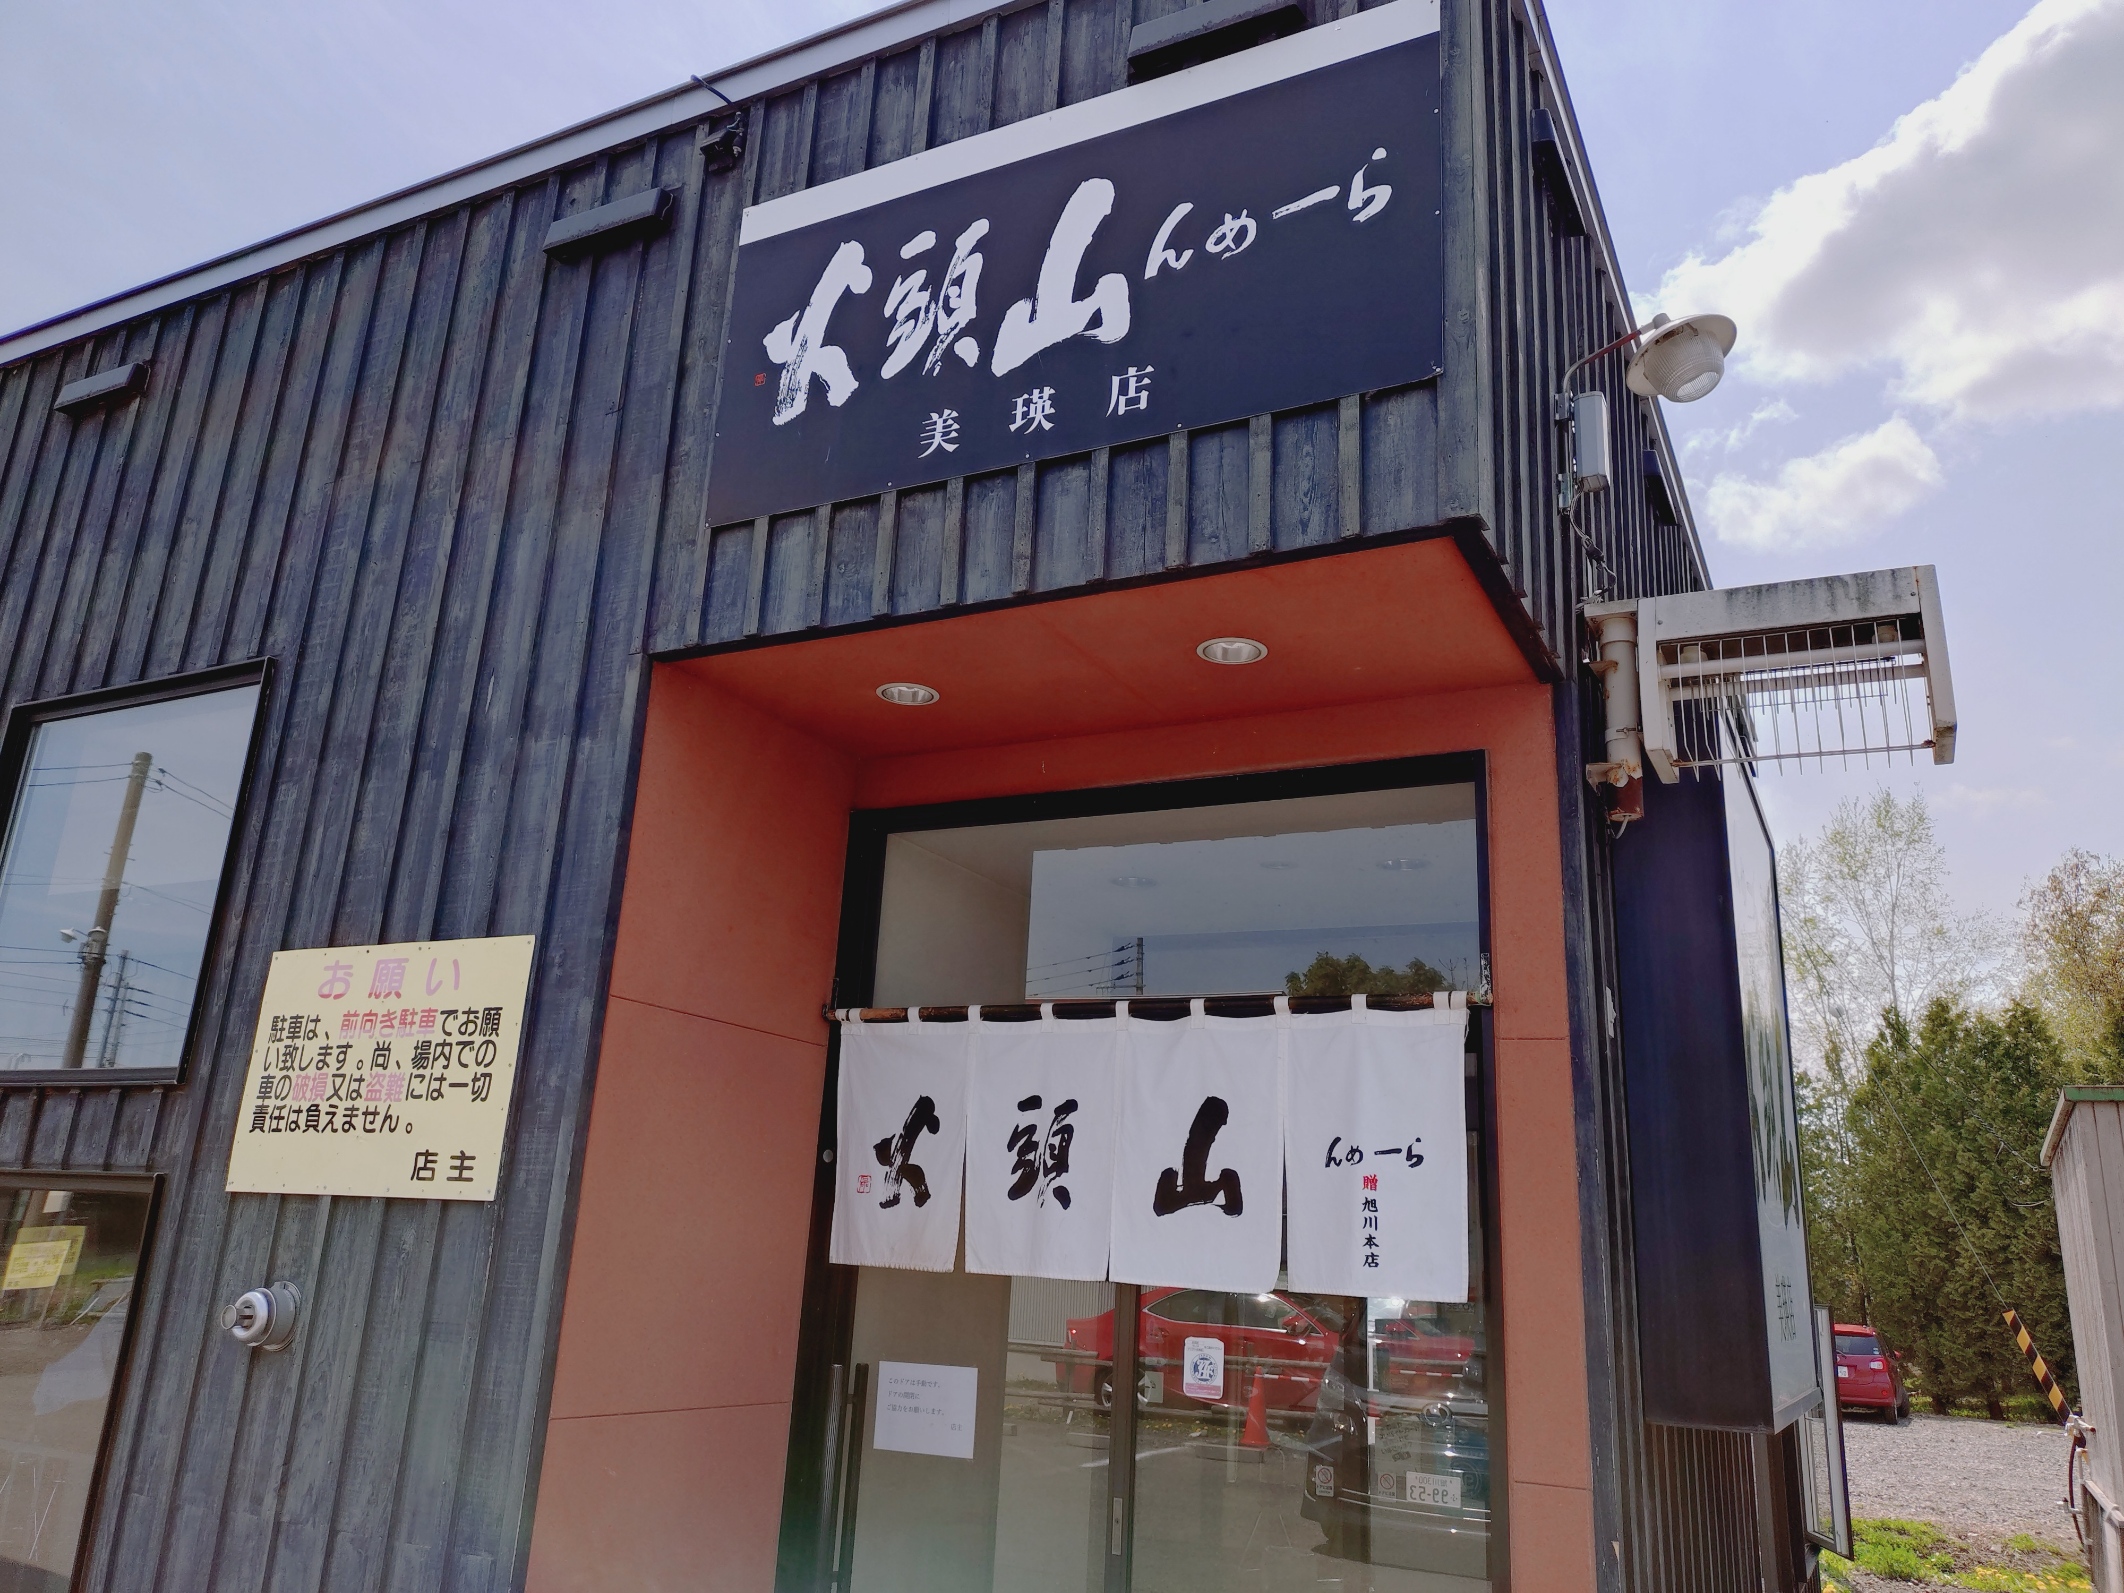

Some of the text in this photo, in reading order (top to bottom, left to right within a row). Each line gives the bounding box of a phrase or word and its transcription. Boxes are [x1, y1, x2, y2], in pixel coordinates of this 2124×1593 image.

[917, 365, 1155, 459] 美瑛店
[317, 957, 461, 1000] お願い
[256, 1071, 493, 1103] 車の破損又は盗難には一切
[249, 1103, 413, 1134] 責任は負えません。
[410, 1149, 476, 1182] 店主
